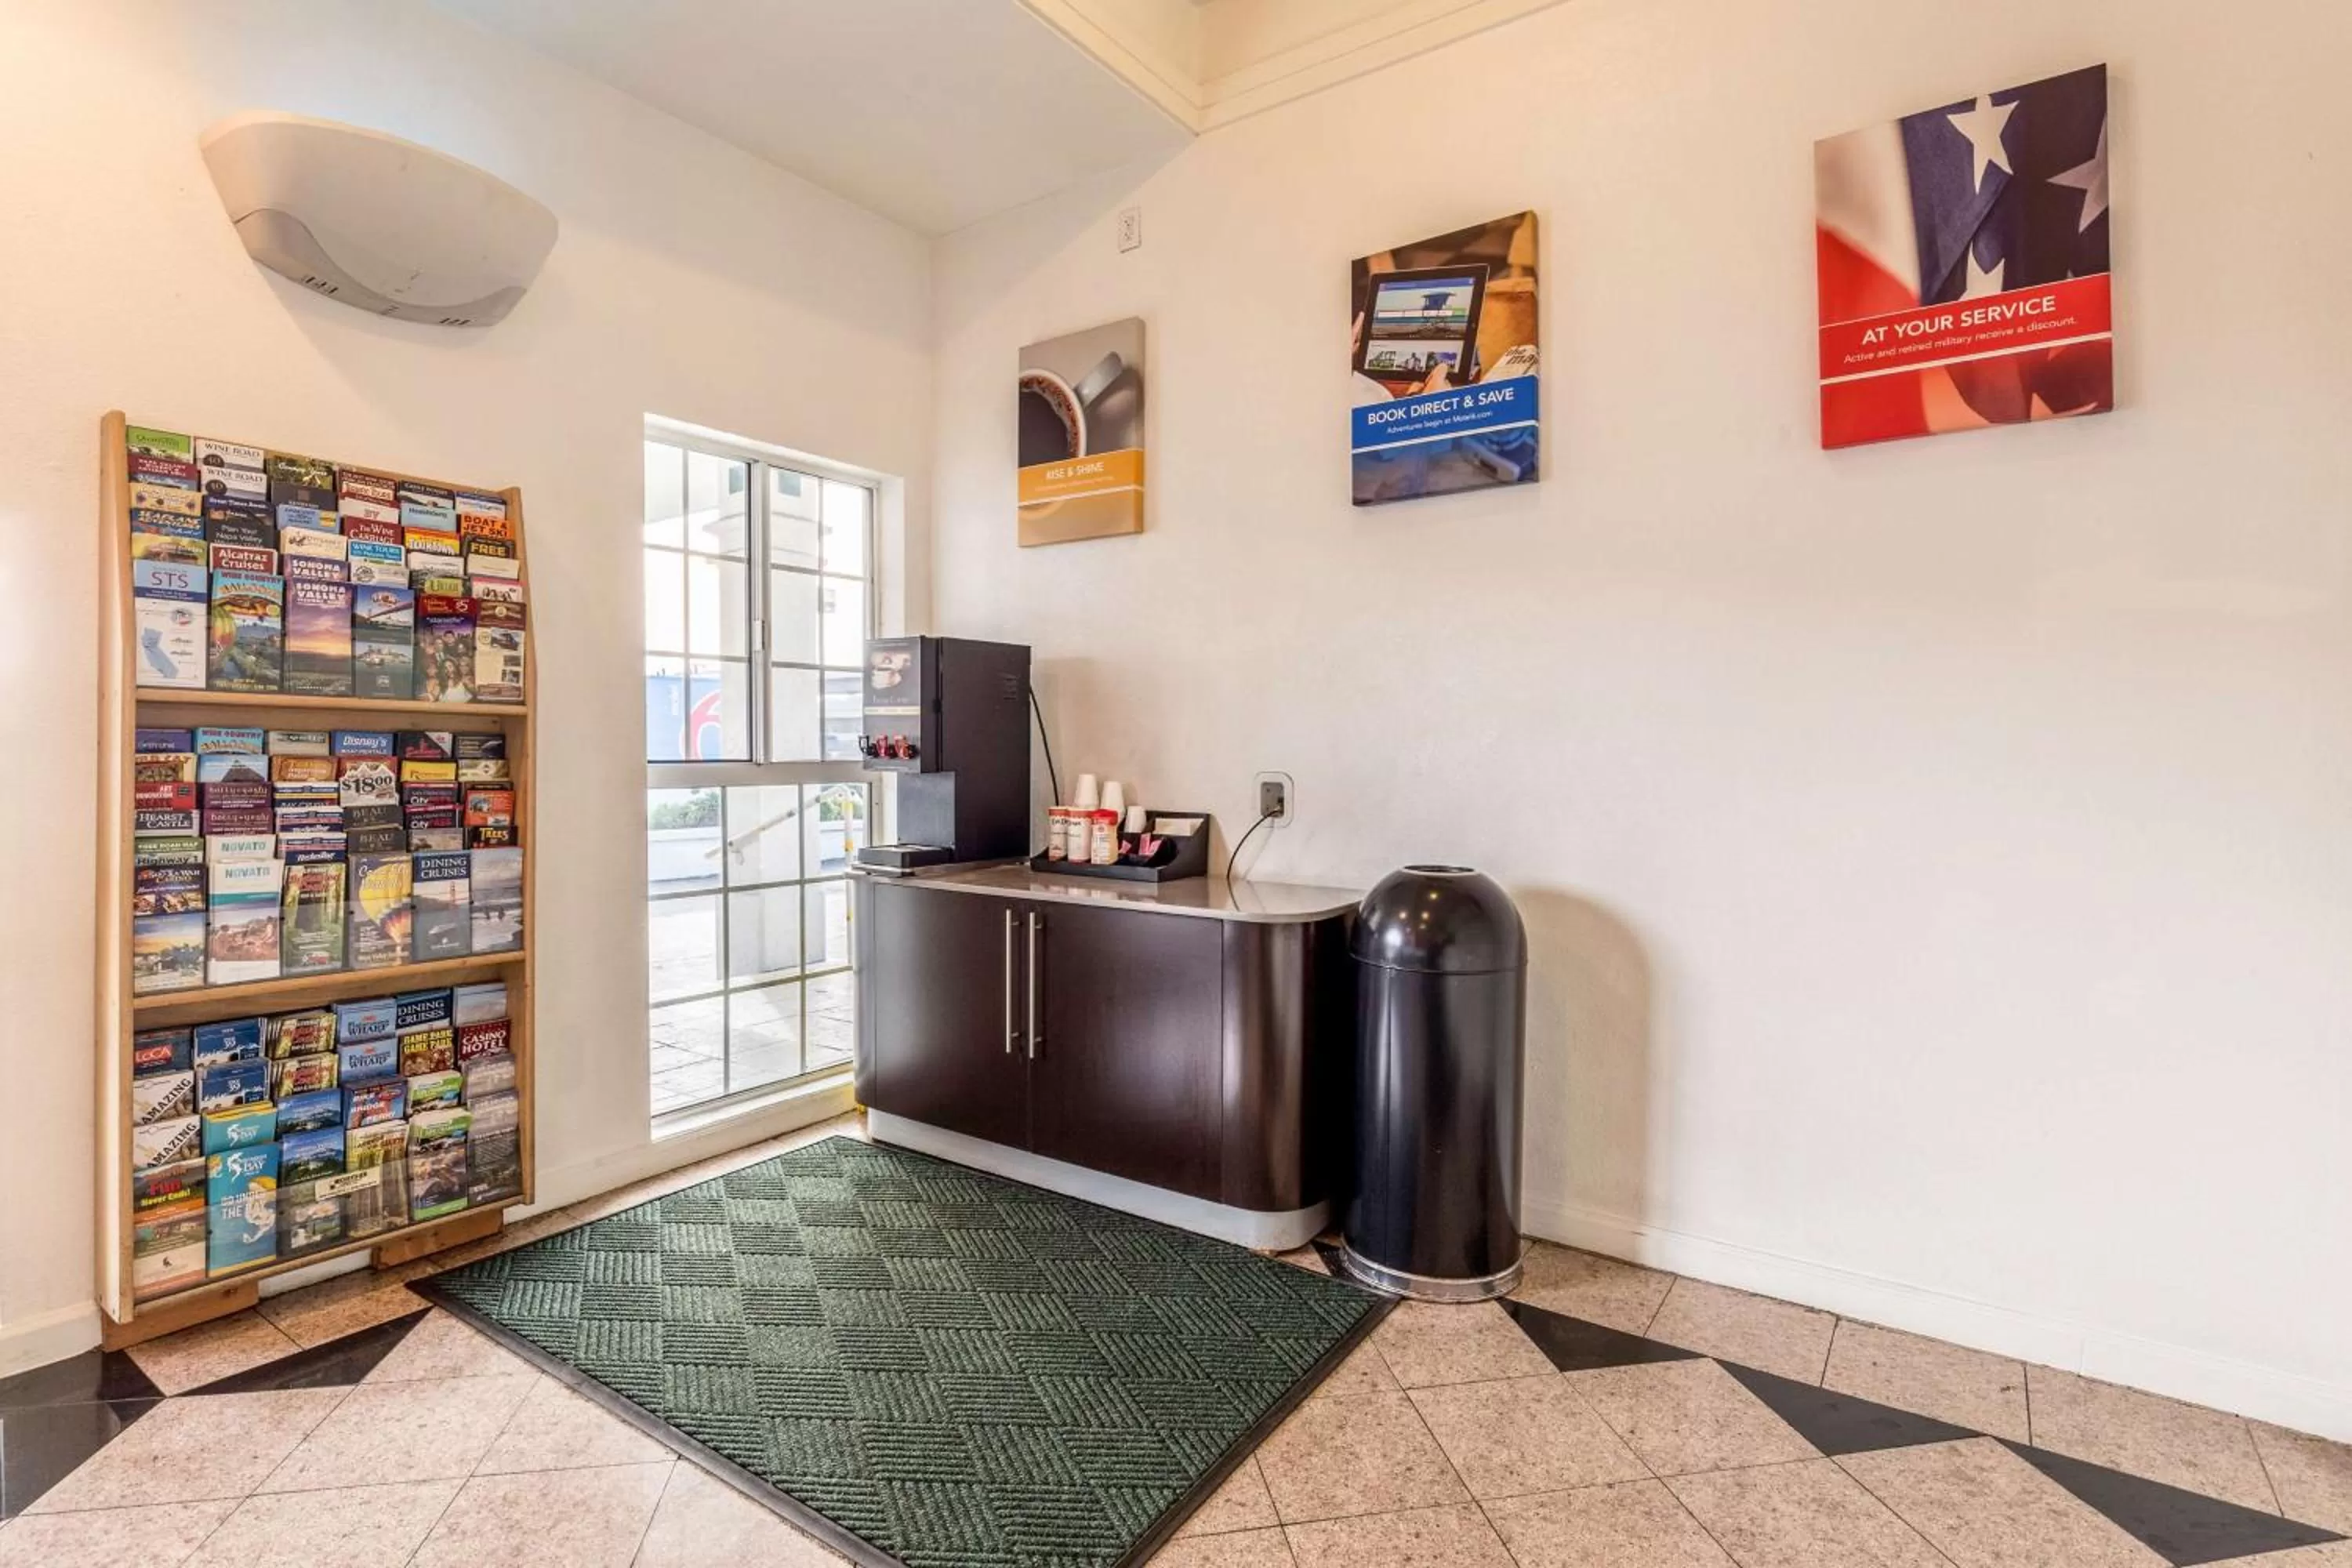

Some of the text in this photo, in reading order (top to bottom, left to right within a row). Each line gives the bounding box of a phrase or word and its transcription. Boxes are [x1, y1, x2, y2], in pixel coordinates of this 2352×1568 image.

[1862, 296, 2056, 345] AT YOUR SERVICE
[1844, 315, 2077, 364] Active and retired military receive a discount.
[1367, 387, 1514, 425] BOOK DIRECT & SAVE
[1386, 421, 1423, 434] Adventures
[1424, 416, 1444, 429] begin
[205, 442, 260, 457] WINE ROAD
[207, 468, 263, 482] WINE ROAD
[1046, 470, 1065, 481] RISE
[1076, 462, 1105, 475] SHINE
[464, 515, 496, 527] BOAT
[463, 524, 507, 536] JET SKI
[219, 549, 268, 562] Alcatraz
[470, 542, 506, 557] FREE
[221, 559, 264, 571] Cruises
[292, 559, 340, 572] SONOMA
[151, 571, 189, 589] STS
[293, 568, 340, 579] VALLEY
[296, 583, 346, 593] SONOMA
[297, 591, 346, 601] VALLEY
[343, 735, 387, 749] Disney's
[140, 813, 184, 822] HEARST
[147, 818, 191, 829] CASTLE
[221, 841, 266, 852] NOVATO
[421, 857, 467, 868] DINING
[225, 866, 270, 879] NOVATO
[421, 868, 467, 879] CRUISES
[397, 999, 445, 1015] DINING
[397, 1009, 445, 1025] CRUISES
[462, 1029, 506, 1045] CASINO
[462, 1040, 506, 1054] HOTEL
[141, 1077, 192, 1125] AMAZING
[147, 1121, 197, 1168] AMAZING
[221, 1205, 242, 1220] THE
